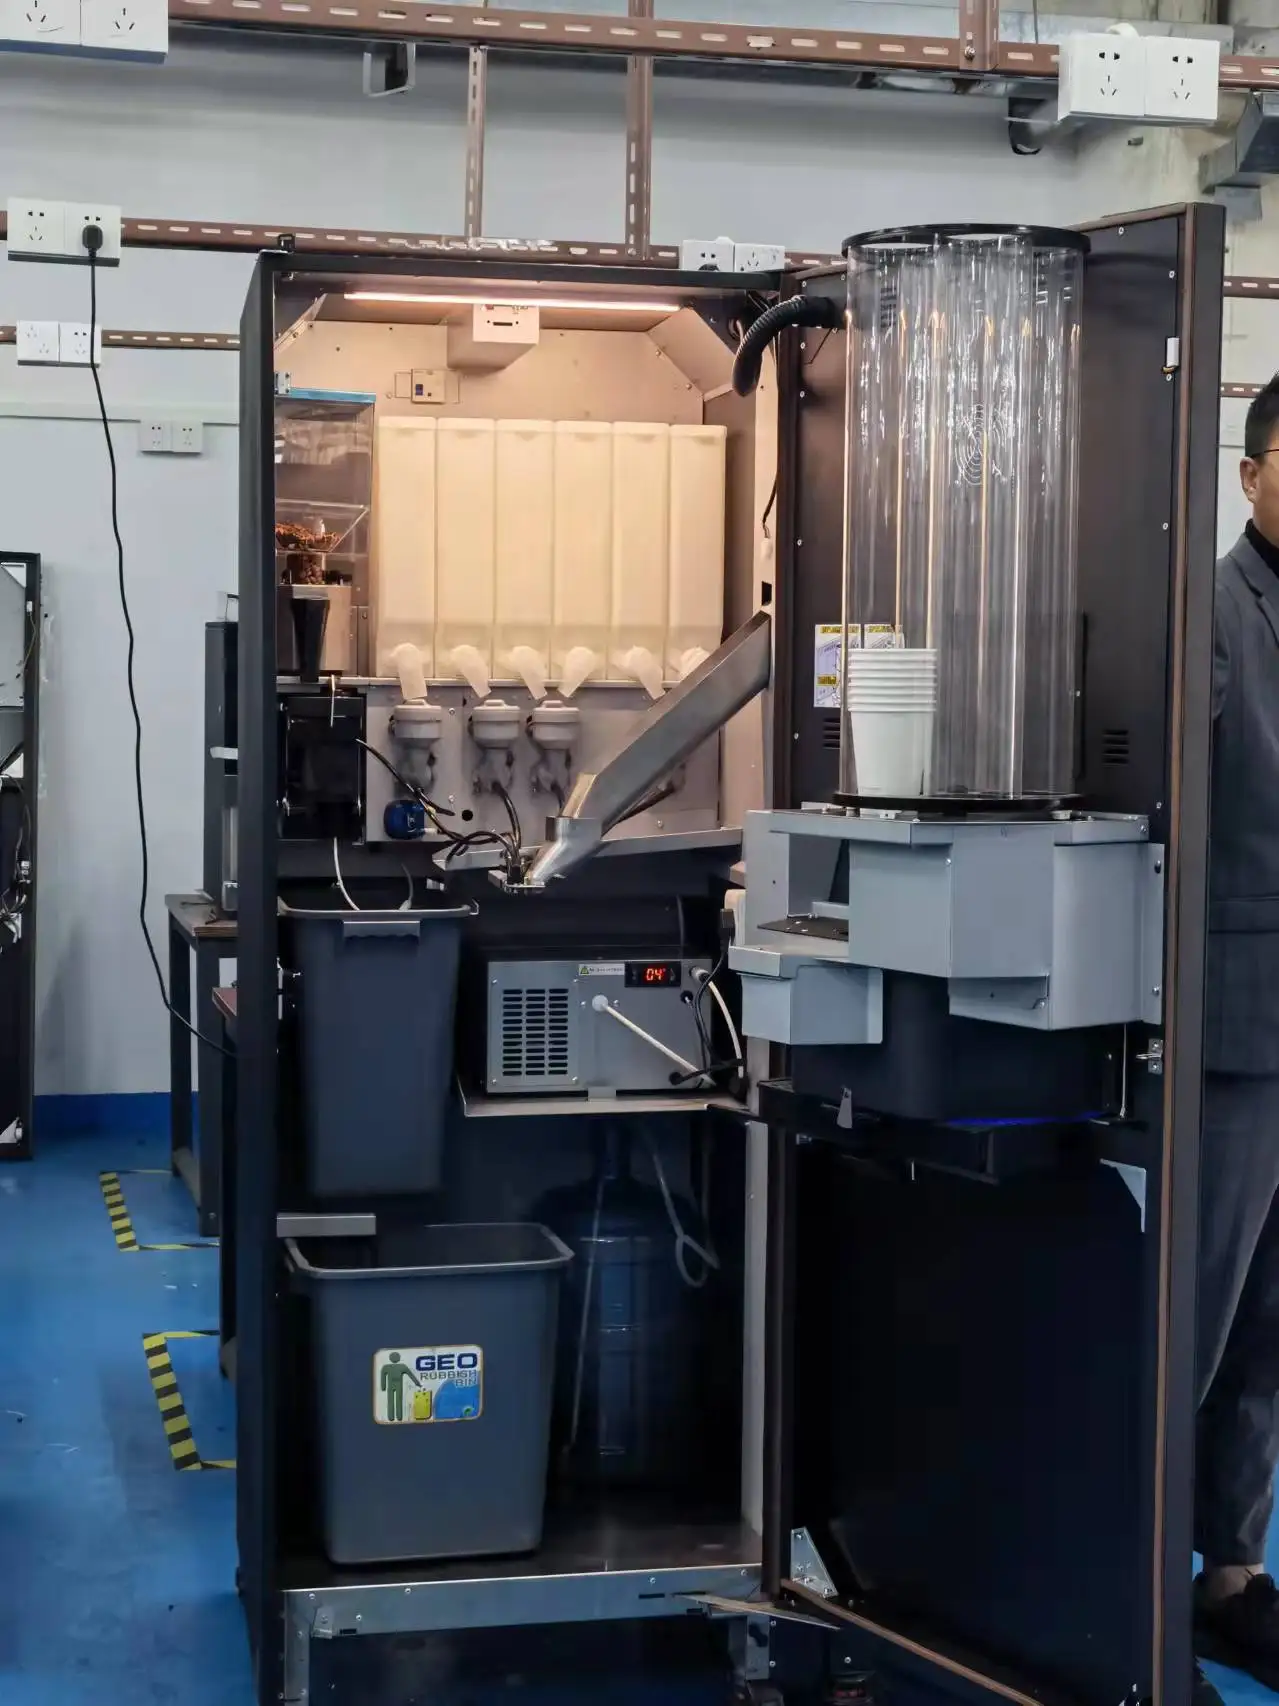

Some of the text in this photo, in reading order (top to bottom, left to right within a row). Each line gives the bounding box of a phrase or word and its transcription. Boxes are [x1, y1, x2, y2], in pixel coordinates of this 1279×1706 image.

[415, 1353, 478, 1371] GEO
[420, 1370, 477, 1380] RUBBISH
[455, 1378, 477, 1387] BIN
